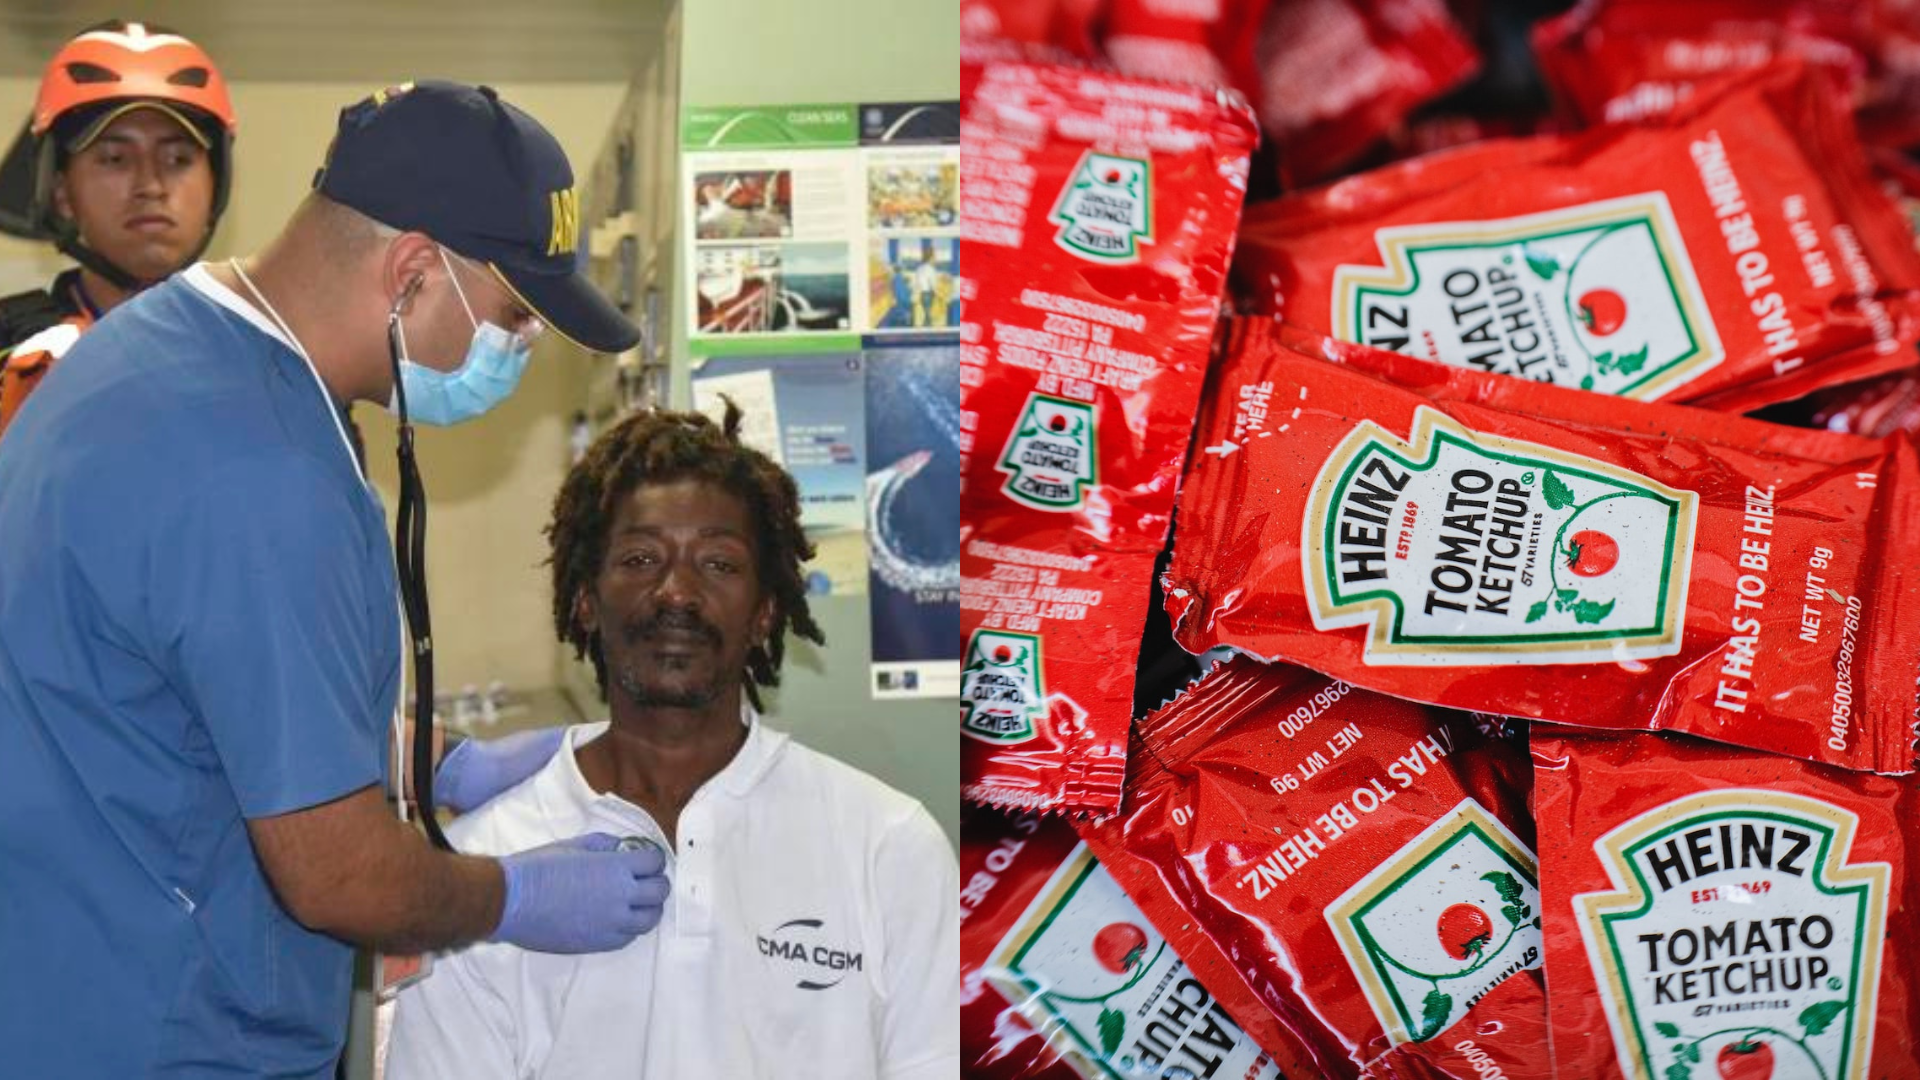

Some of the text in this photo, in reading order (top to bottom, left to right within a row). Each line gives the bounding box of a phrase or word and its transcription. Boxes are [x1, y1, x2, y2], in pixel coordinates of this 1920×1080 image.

[1736, 251, 1774, 297] TO
[1750, 292, 1799, 356] HAS
[1234, 385, 1257, 437] TEAR
[1246, 381, 1274, 430] HERE
[1020, 477, 1071, 498] HEINZ
[1340, 457, 1412, 584] HEINZ
[1401, 500, 1419, 530] 1869
[1524, 512, 1543, 569] VARIETIES
[1424, 469, 1494, 616] TOMATO
[1475, 478, 1531, 616] KETCHUP
[1740, 538, 1771, 572] BE
[1031, 584, 1102, 608] COMPANY
[1037, 598, 1089, 621] KRAFT
[1734, 574, 1766, 610] TO
[1800, 546, 1833, 643] NET WT 9g
[1721, 617, 1761, 680] HAS
[1827, 595, 1862, 752] 04050032967600
[1277, 679, 1355, 739] 2967600
[1714, 680, 1748, 713] IT
[1269, 722, 1363, 795] NET WT 9g
[1387, 734, 1448, 788] HAS
[1352, 777, 1397, 813] TO
[1315, 802, 1359, 841] BE
[985, 837, 1027, 873] TO
[1235, 827, 1327, 901] HEINZ.
[1644, 824, 1811, 893] HEINZ
[757, 935, 862, 972] CMA CGM
[1638, 915, 1834, 972] TOMATO
[1652, 956, 1829, 1005] KETCHUP
